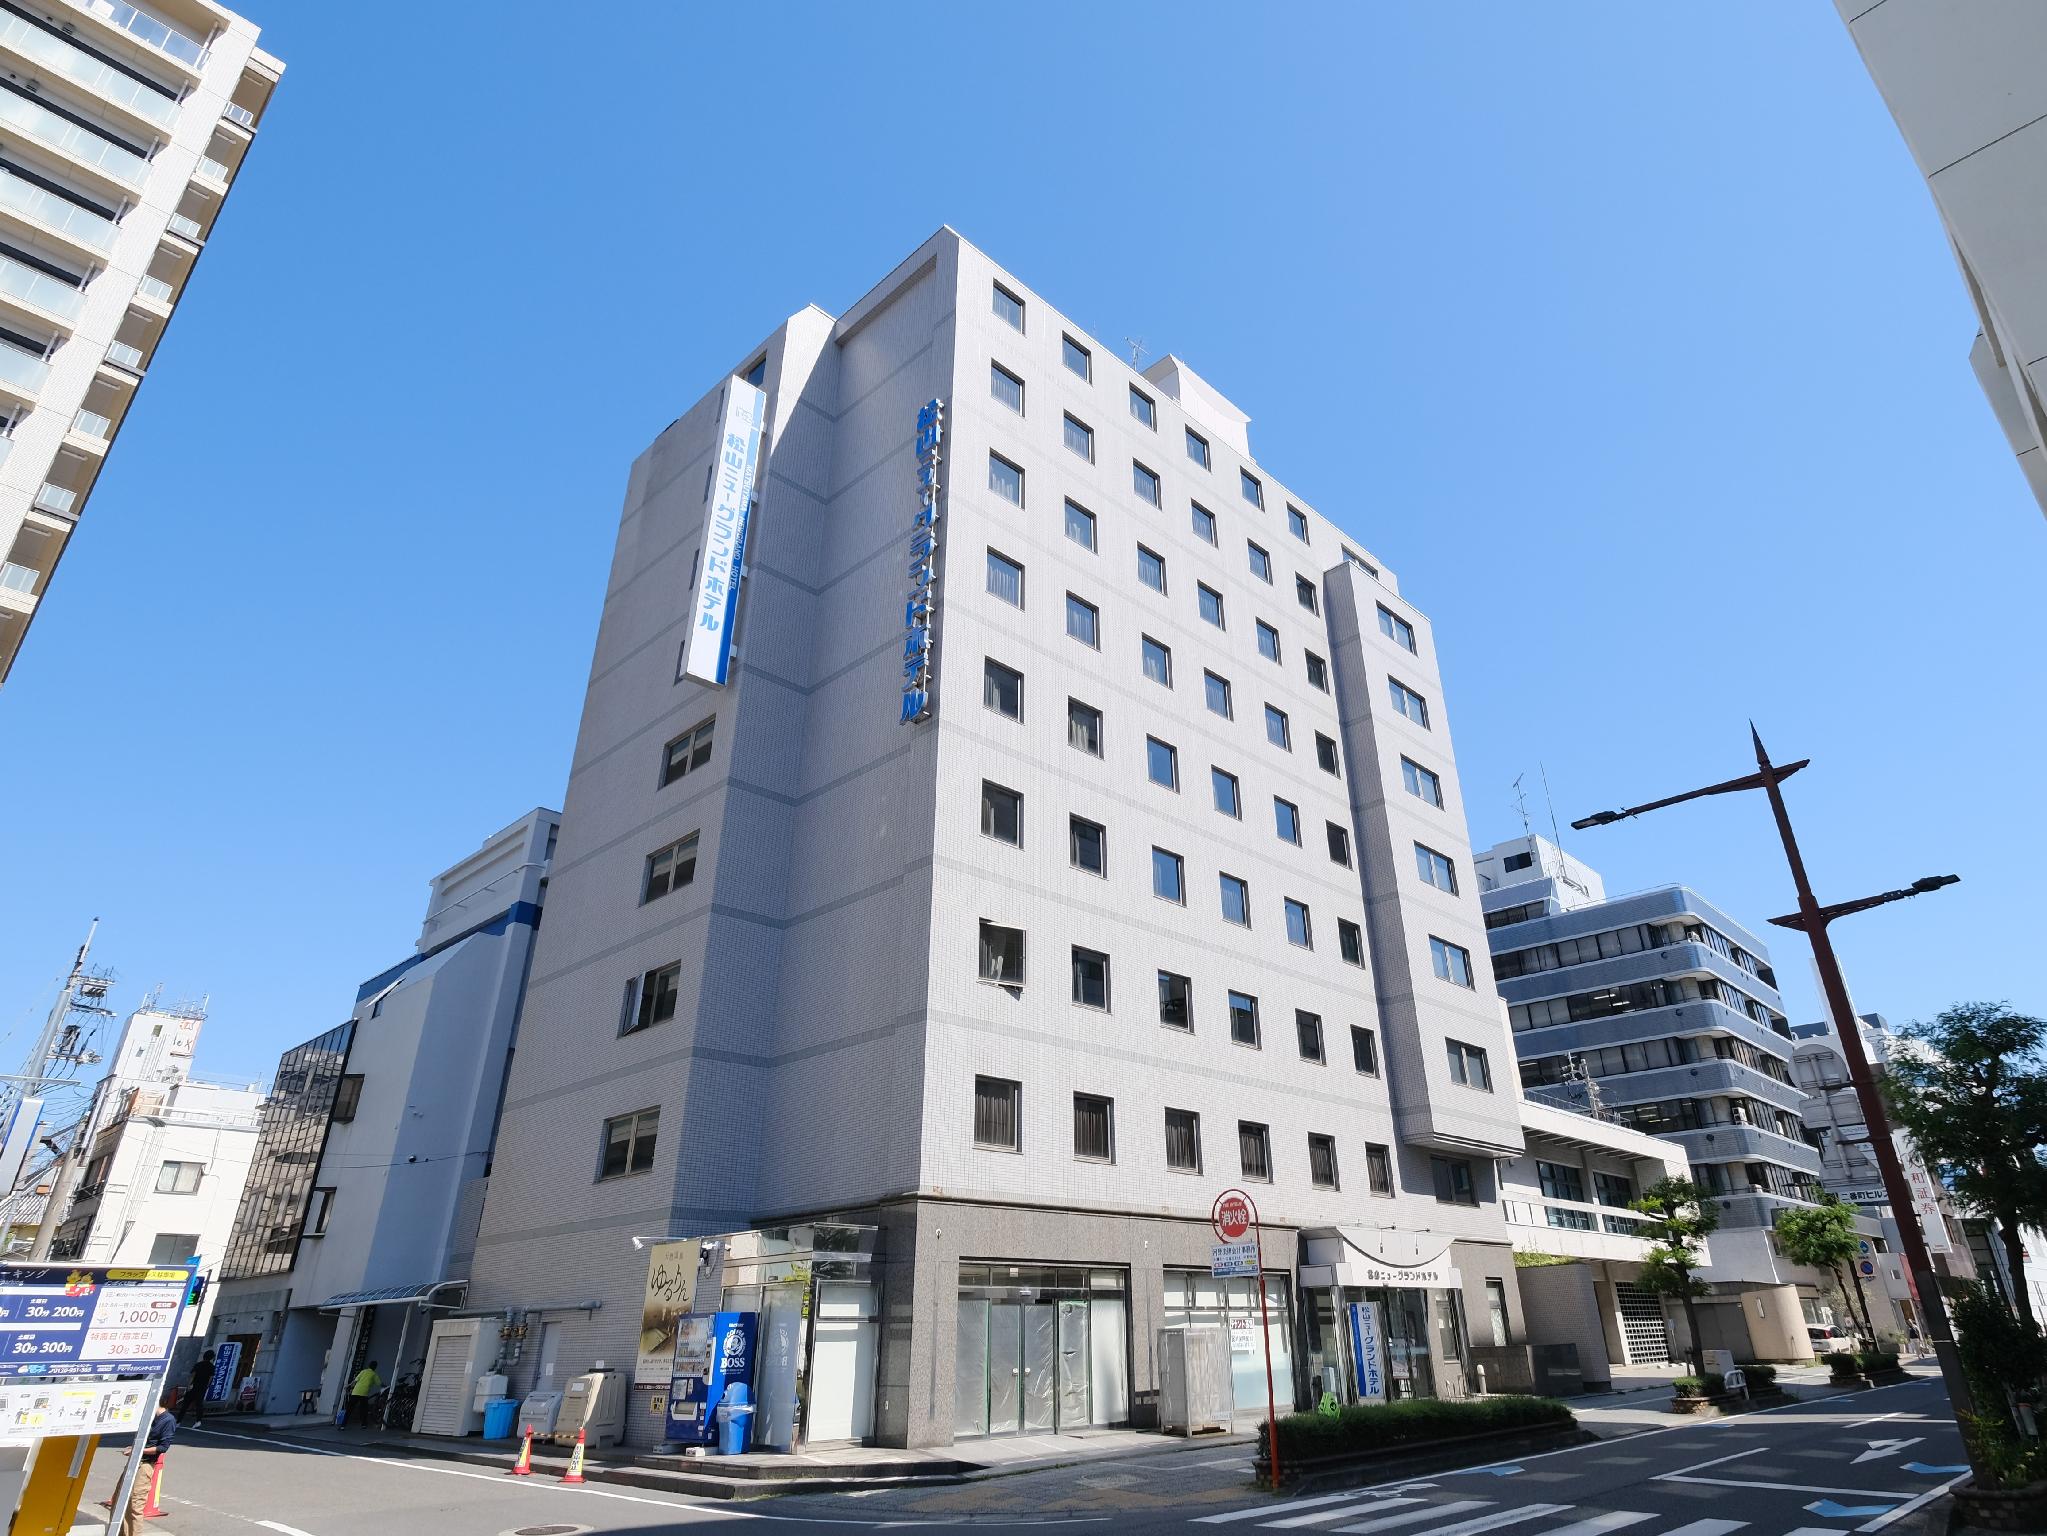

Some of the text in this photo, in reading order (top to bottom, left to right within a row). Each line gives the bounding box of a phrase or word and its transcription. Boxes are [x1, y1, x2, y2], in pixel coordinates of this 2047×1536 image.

[739, 464, 754, 512] MATSUYAMA
[699, 432, 746, 632] 松山ニューグランドホテル
[728, 565, 740, 591] HOTEL
[1221, 1209, 1248, 1226] 消火栓
[1367, 1269, 1439, 1281] ニューグランドホテル
[25, 1306, 86, 1318] 30分 200円
[119, 1310, 167, 1324] 1,000円
[90, 1331, 153, 1341] 特日(指定日)
[12, 1341, 73, 1354] 30分 300円
[108, 1343, 163, 1355] 30分 300円
[1361, 1306, 1380, 1395] 松山ニューグランドホテル
[720, 1357, 746, 1368] BOSS
